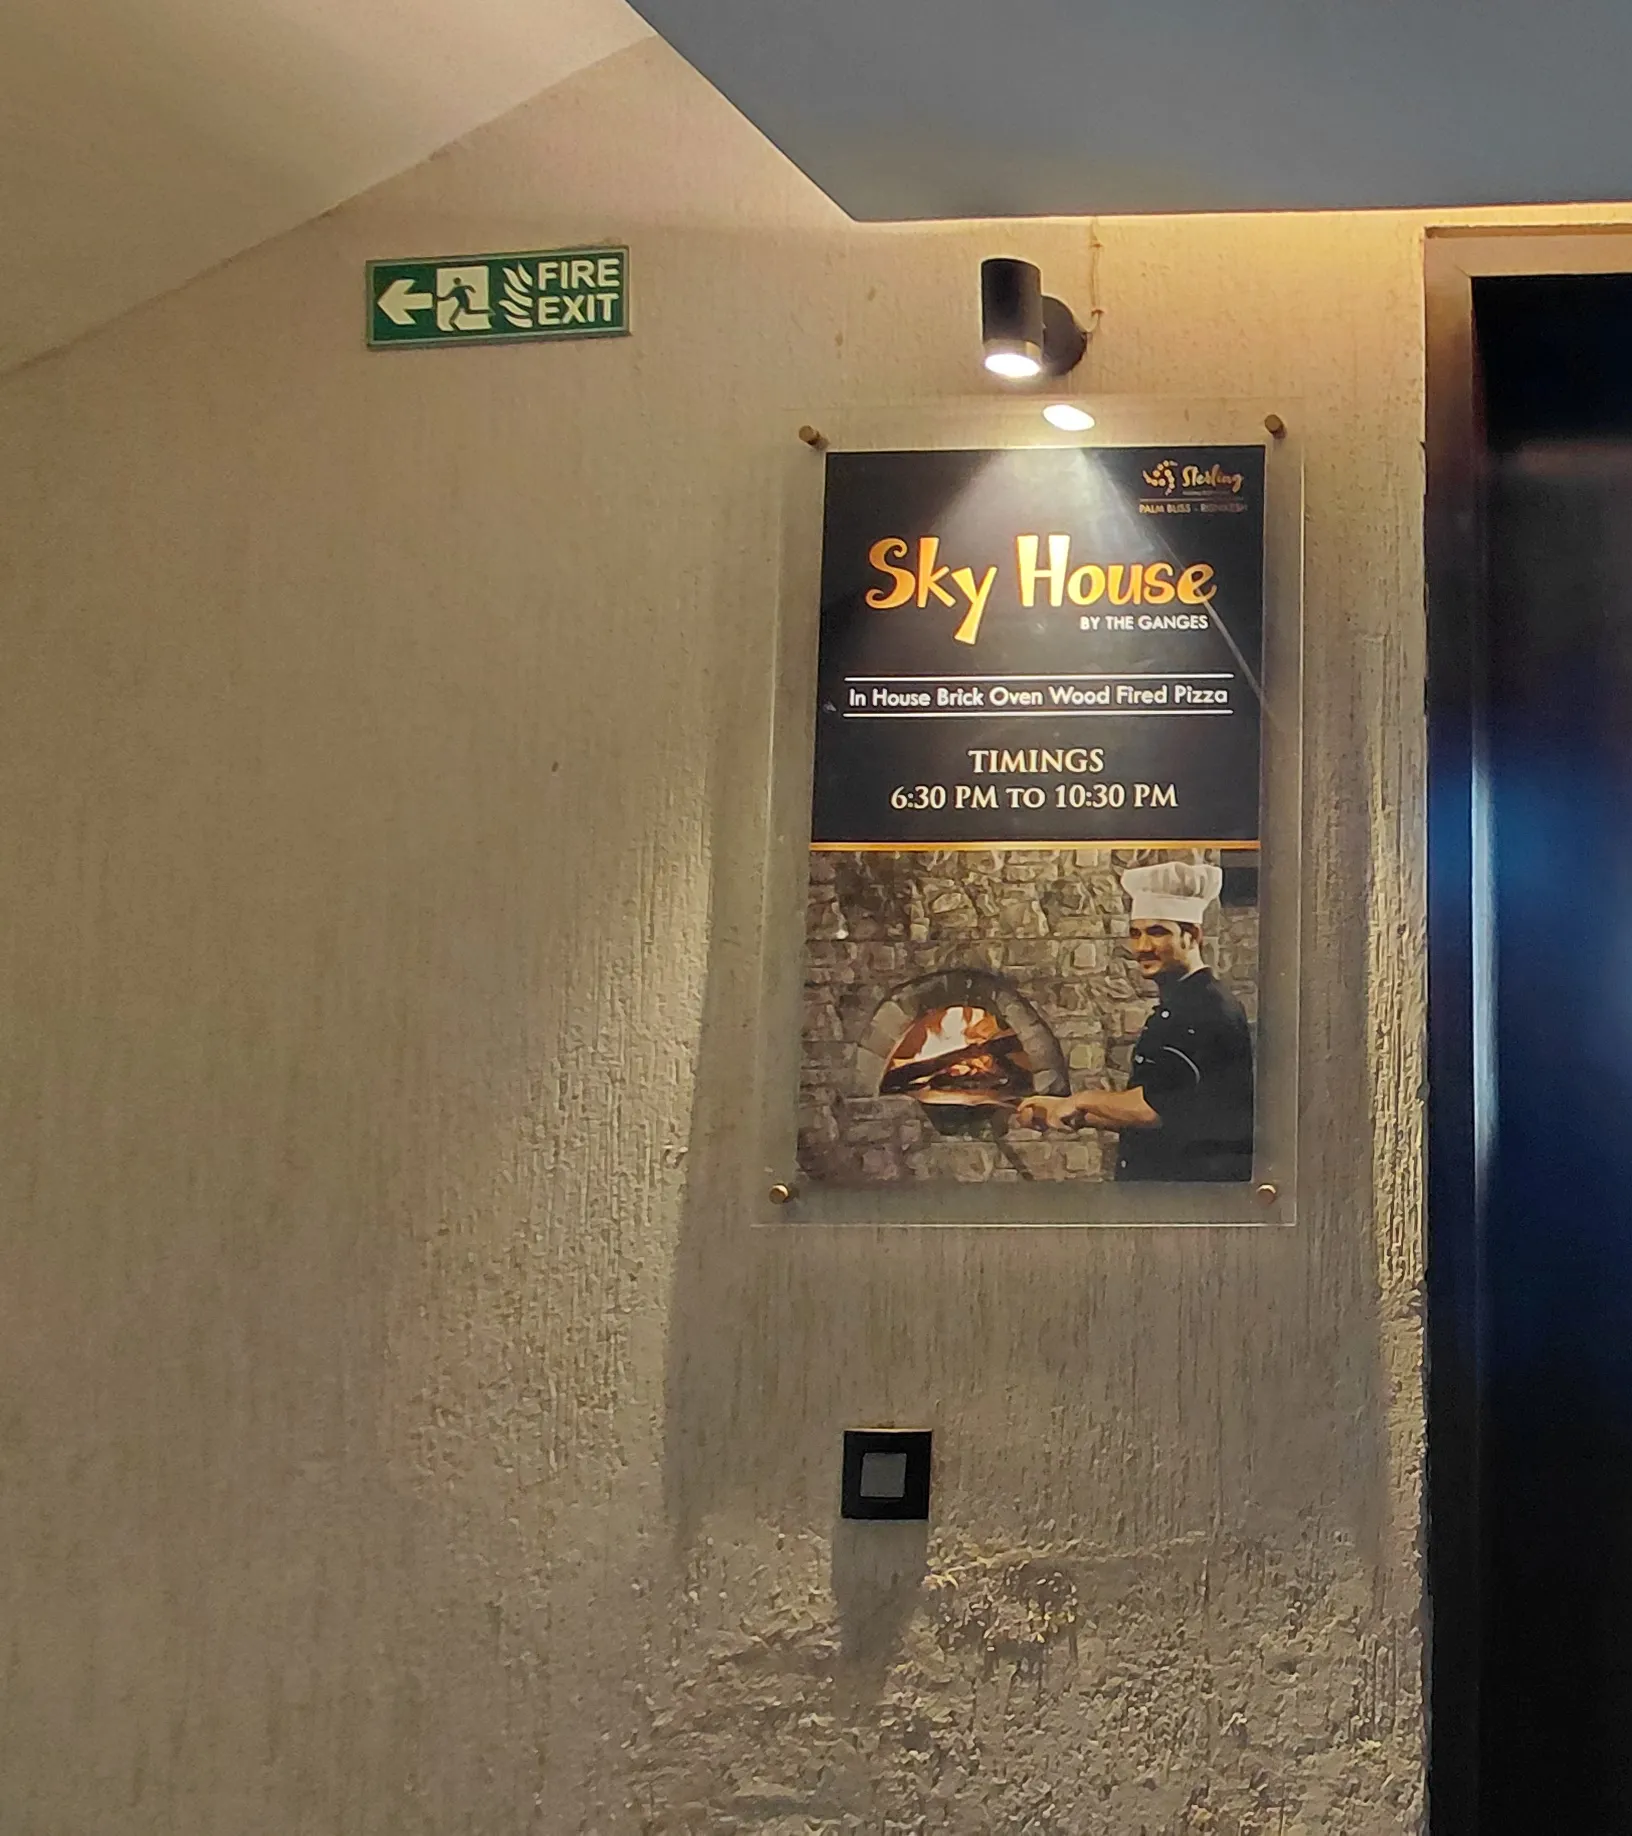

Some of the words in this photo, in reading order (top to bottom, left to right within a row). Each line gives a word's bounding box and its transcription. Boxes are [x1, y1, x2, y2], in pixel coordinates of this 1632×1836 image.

[537, 258, 620, 291] FIRE
[538, 293, 620, 326] EXIT
[1139, 503, 1165, 514] PALM
[1166, 503, 1191, 514] BLISS
[864, 536, 998, 645] Sky
[1016, 534, 1217, 608] House
[1080, 616, 1101, 630] BY
[1105, 616, 1134, 630] THE
[1138, 615, 1209, 630] GANGES
[850, 688, 867, 707] In
[872, 688, 931, 707] House
[937, 687, 985, 706] Brick
[989, 686, 1043, 706] Oven
[1048, 685, 1110, 705] Wood
[1116, 685, 1168, 704] Fired
[1174, 684, 1228, 703] Pizza
[967, 748, 1104, 774] TIMINGS
[890, 785, 947, 809] 6:30
[954, 785, 999, 809] PM
[1005, 787, 1046, 809] TO
[1055, 784, 1126, 808] 10:30
[1133, 783, 1179, 807] PM
